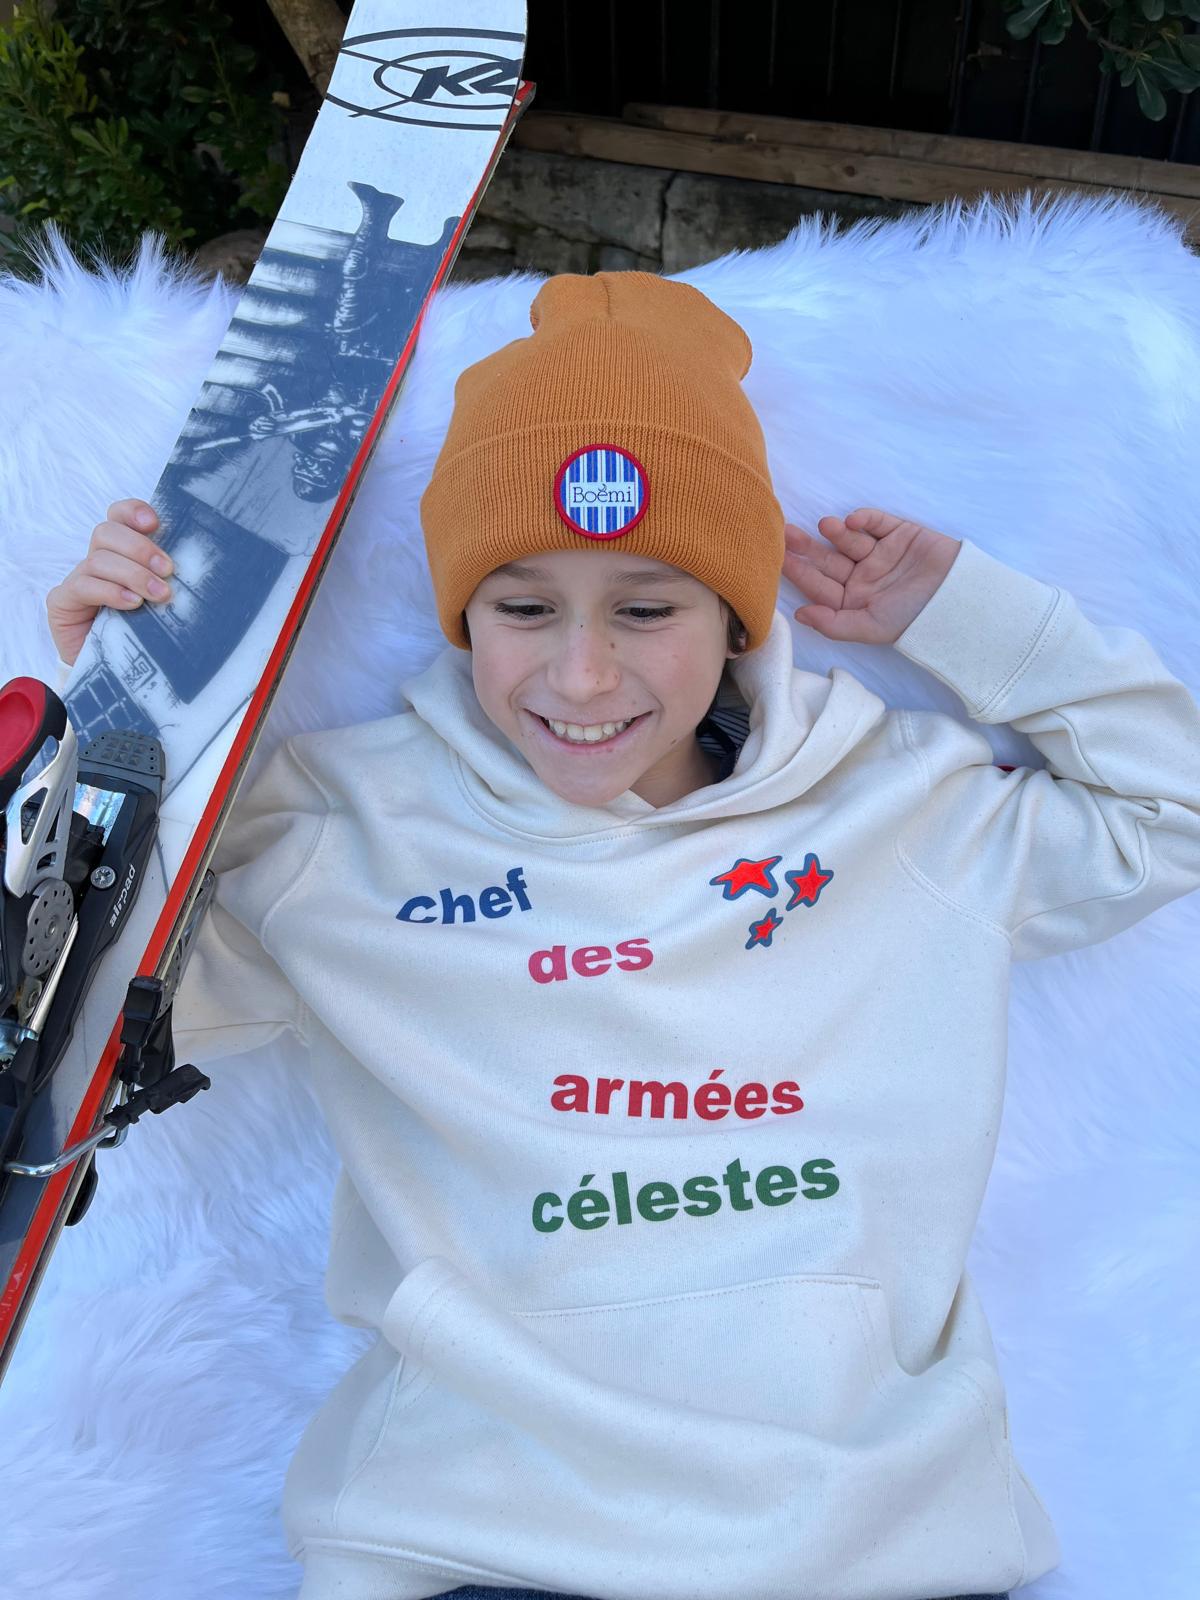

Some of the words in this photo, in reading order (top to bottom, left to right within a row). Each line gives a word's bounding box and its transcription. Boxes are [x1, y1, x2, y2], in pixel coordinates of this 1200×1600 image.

[109, 863, 136, 928] airpad
[396, 867, 532, 924] chef
[528, 938, 654, 984] des
[551, 1069, 804, 1120] armées
[532, 1158, 840, 1232] célestes
